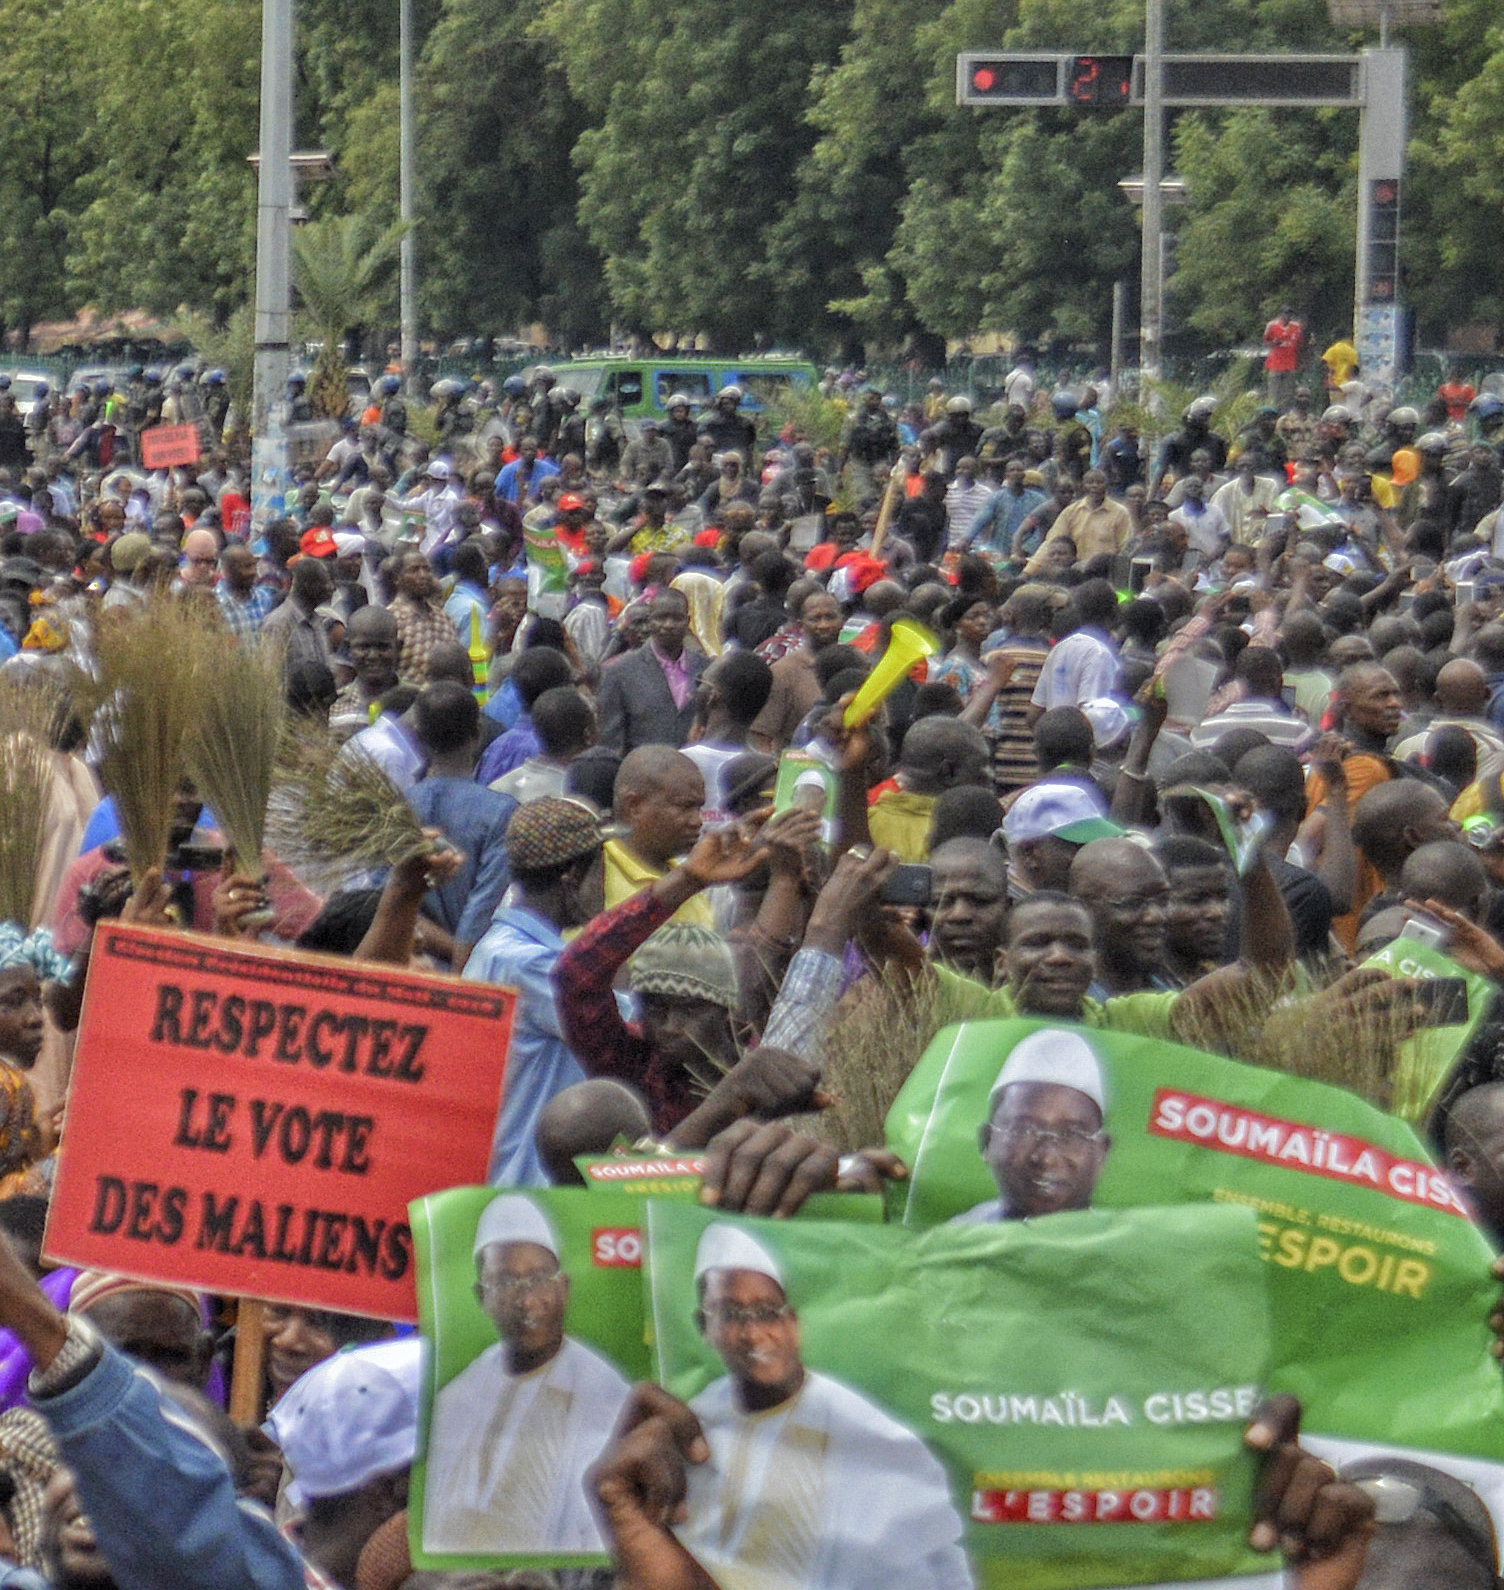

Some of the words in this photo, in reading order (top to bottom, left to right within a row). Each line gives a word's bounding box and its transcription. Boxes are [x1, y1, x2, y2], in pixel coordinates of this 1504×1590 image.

[148, 982, 431, 1085] RESPECTEZ
[171, 1088, 237, 1155] LE
[247, 1098, 375, 1176] VOTE
[1155, 1096, 1379, 1184] SOUMAÏLA
[90, 1174, 189, 1247] DES
[195, 1189, 415, 1282] MALIENS
[929, 1391, 1133, 1428] SOUMAÏLA
[971, 1487, 1214, 1522] L'ESPOIR
